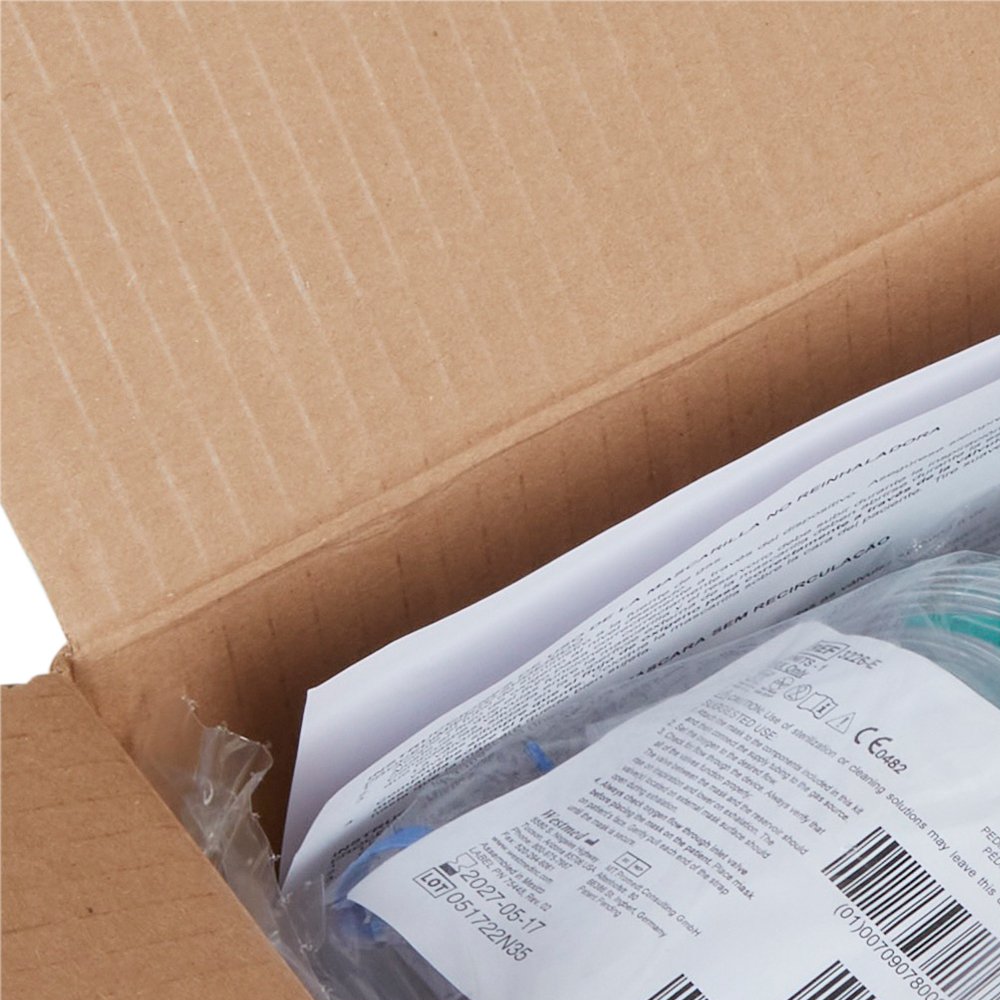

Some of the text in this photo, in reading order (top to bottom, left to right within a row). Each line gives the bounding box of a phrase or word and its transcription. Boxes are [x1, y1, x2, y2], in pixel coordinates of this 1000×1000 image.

[630, 637, 706, 679] ASCARA
[711, 611, 749, 637] SEM
[873, 747, 909, 775] 0482
[538, 807, 590, 841] Westmed
[835, 755, 850, 766] or
[845, 762, 888, 795] cleaning
[883, 789, 929, 831] solutions
[923, 828, 951, 856] may
[946, 849, 978, 879] leave
[975, 874, 999, 897] this
[421, 872, 533, 962] LOT 051722N35
[455, 866, 547, 937] 2027-05-17
[634, 910, 668, 939] Germany
[638, 887, 678, 918] Consulting
[674, 913, 702, 937] GmbH
